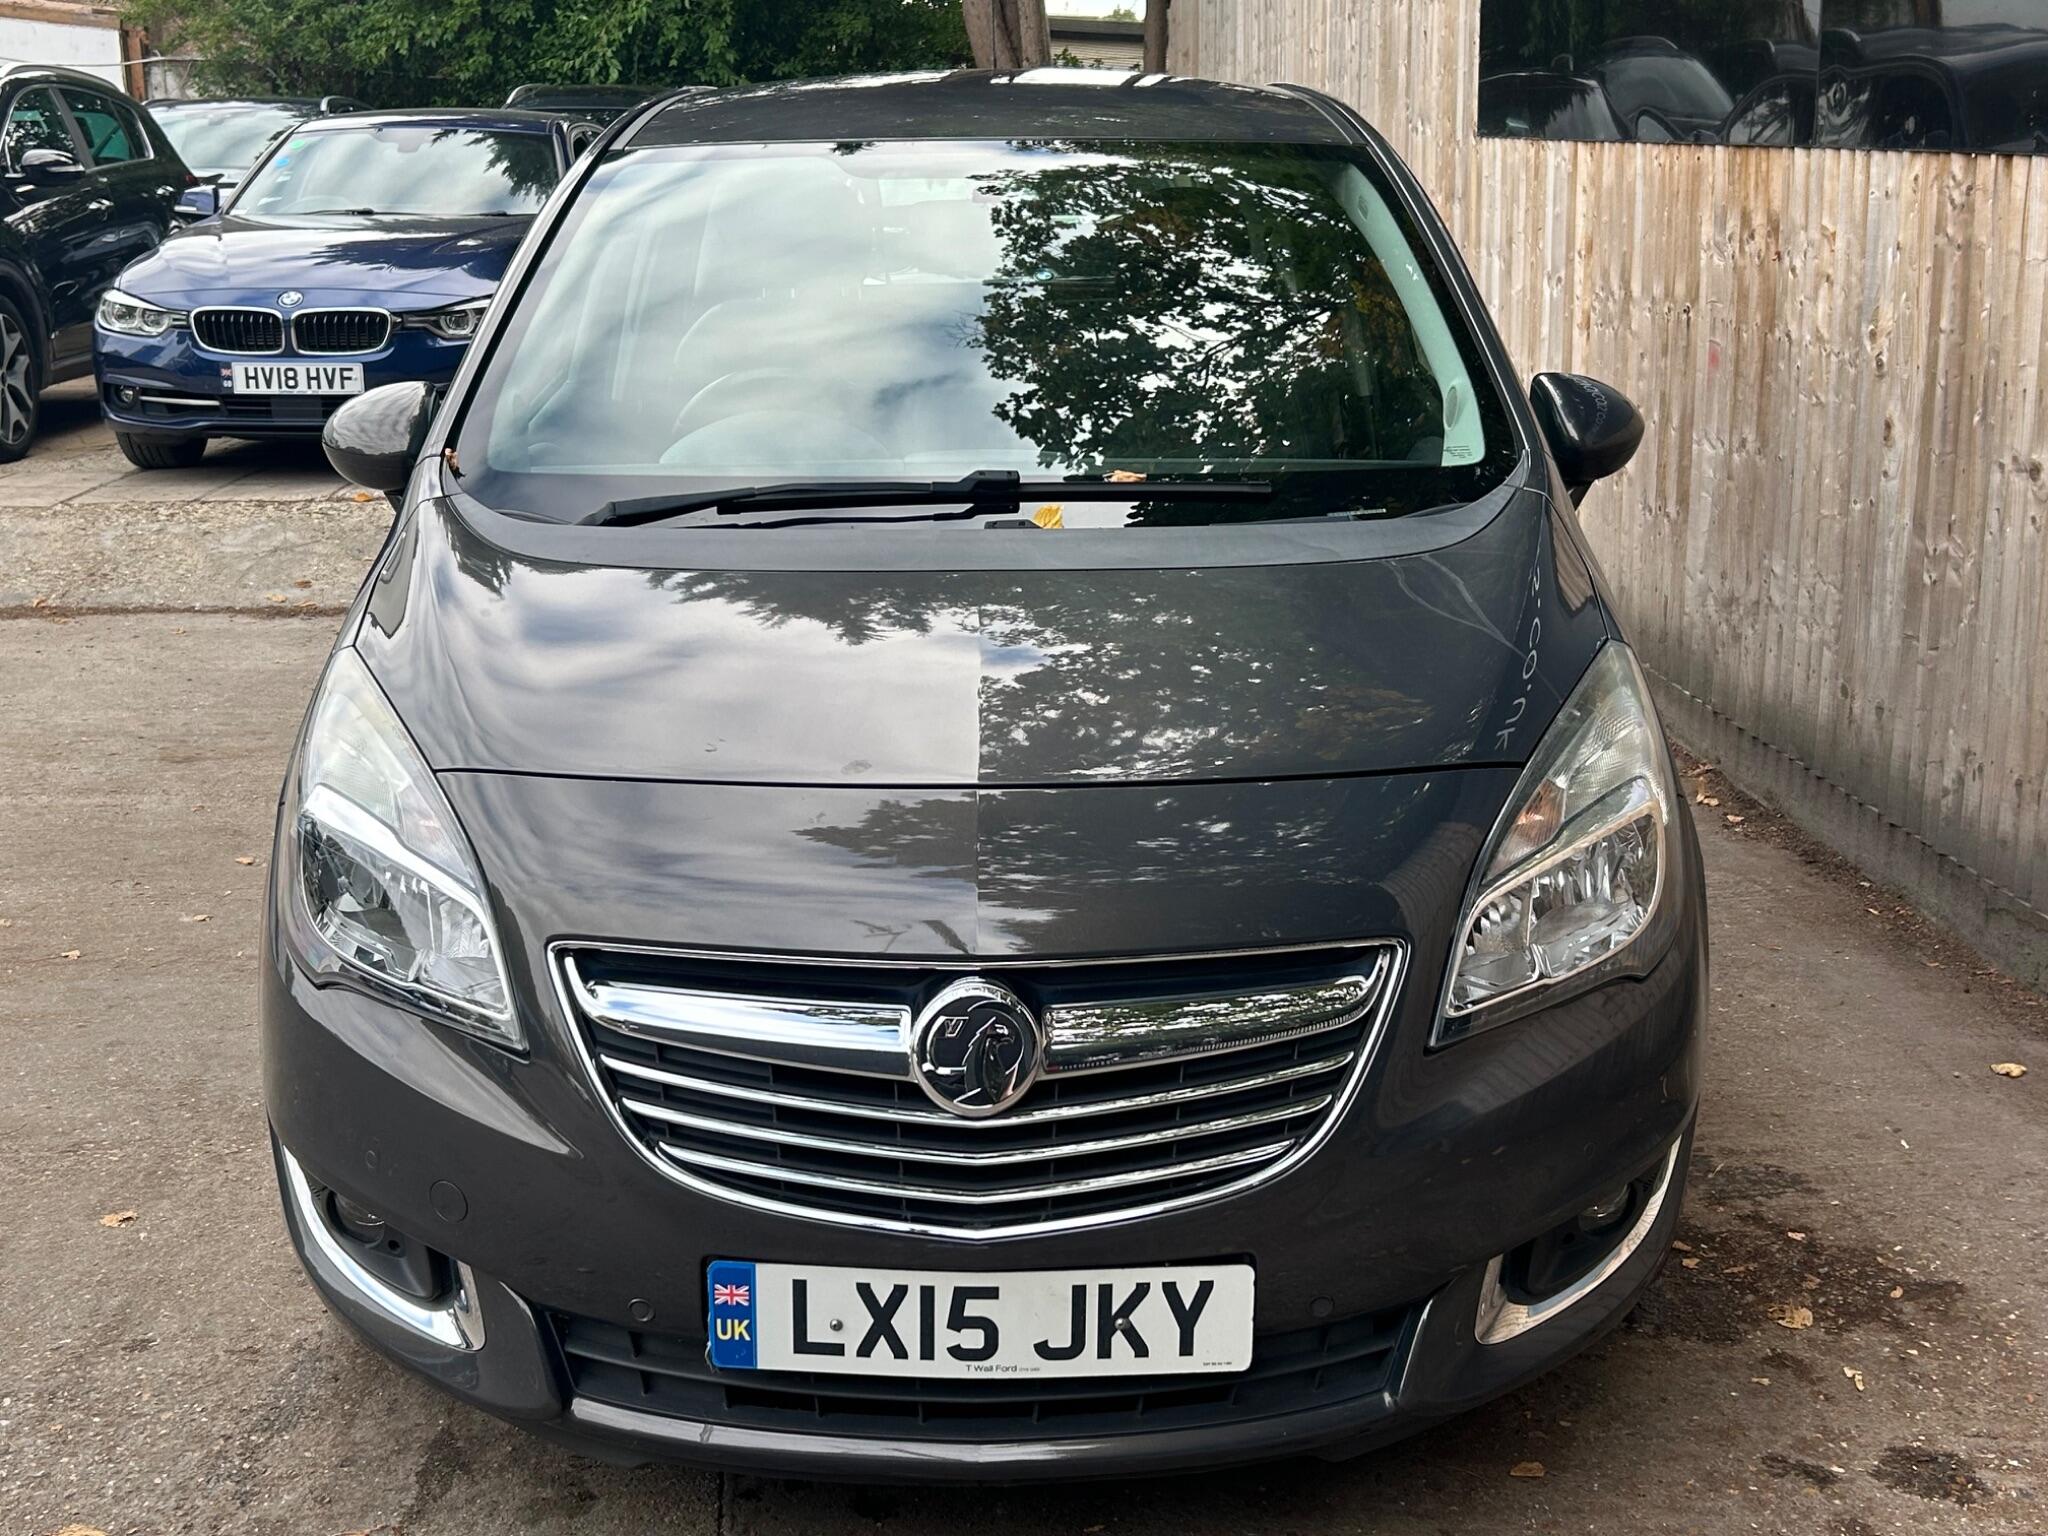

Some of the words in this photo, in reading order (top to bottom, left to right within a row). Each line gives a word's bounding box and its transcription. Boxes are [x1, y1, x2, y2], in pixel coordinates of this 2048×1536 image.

[244, 367, 299, 390] HV18
[306, 367, 354, 390] HVF
[715, 1319, 751, 1342] UK
[790, 1278, 1000, 1362] LX15
[1033, 1280, 1215, 1361] JKY
[974, 1364, 994, 1373] Wall
[995, 1364, 1018, 1373] Ford
